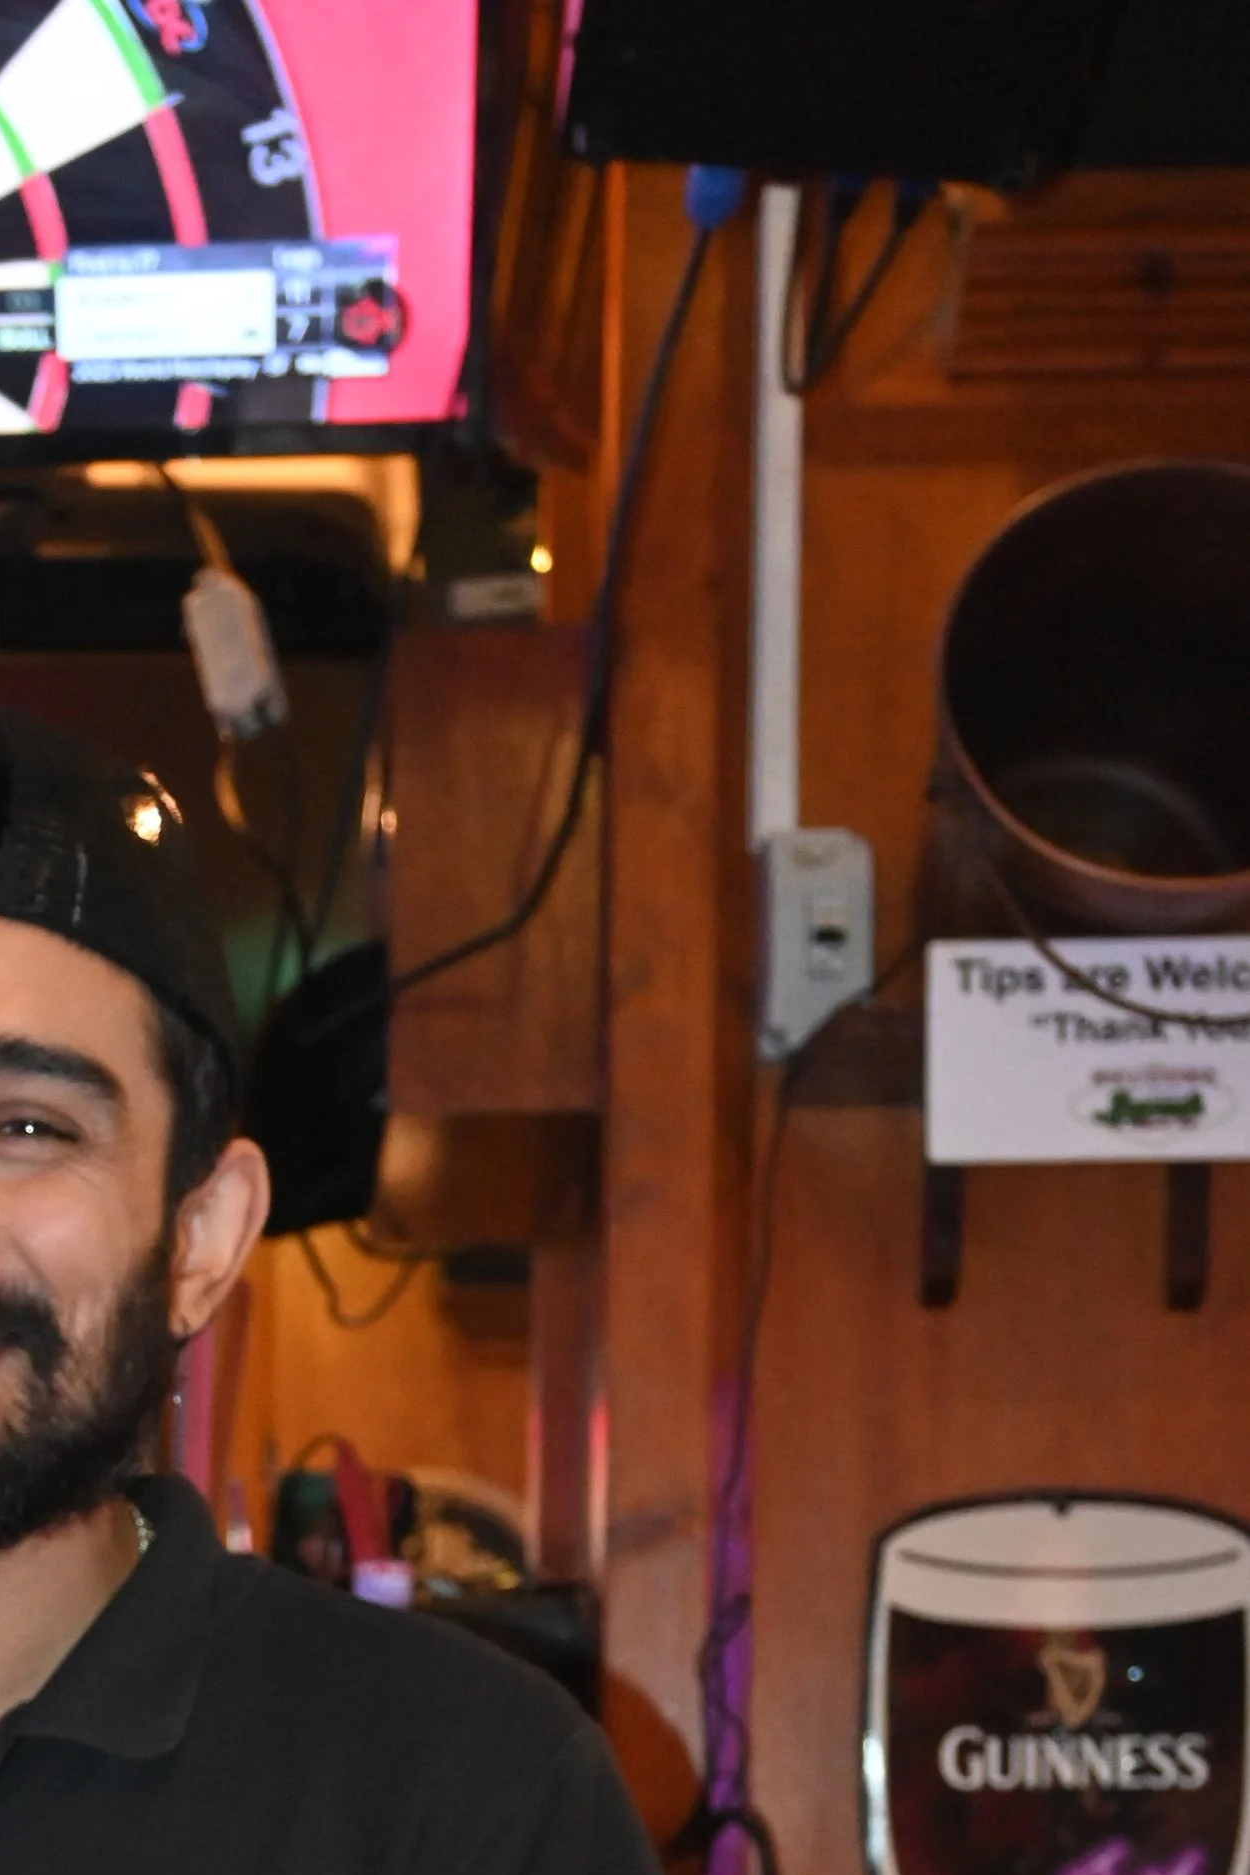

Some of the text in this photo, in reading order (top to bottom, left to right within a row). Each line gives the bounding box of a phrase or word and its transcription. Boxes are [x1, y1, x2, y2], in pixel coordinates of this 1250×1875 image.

[241, 108, 307, 188] 13
[953, 955, 1046, 1003] Tips
[937, 1724, 1212, 1794] GUINNESS
